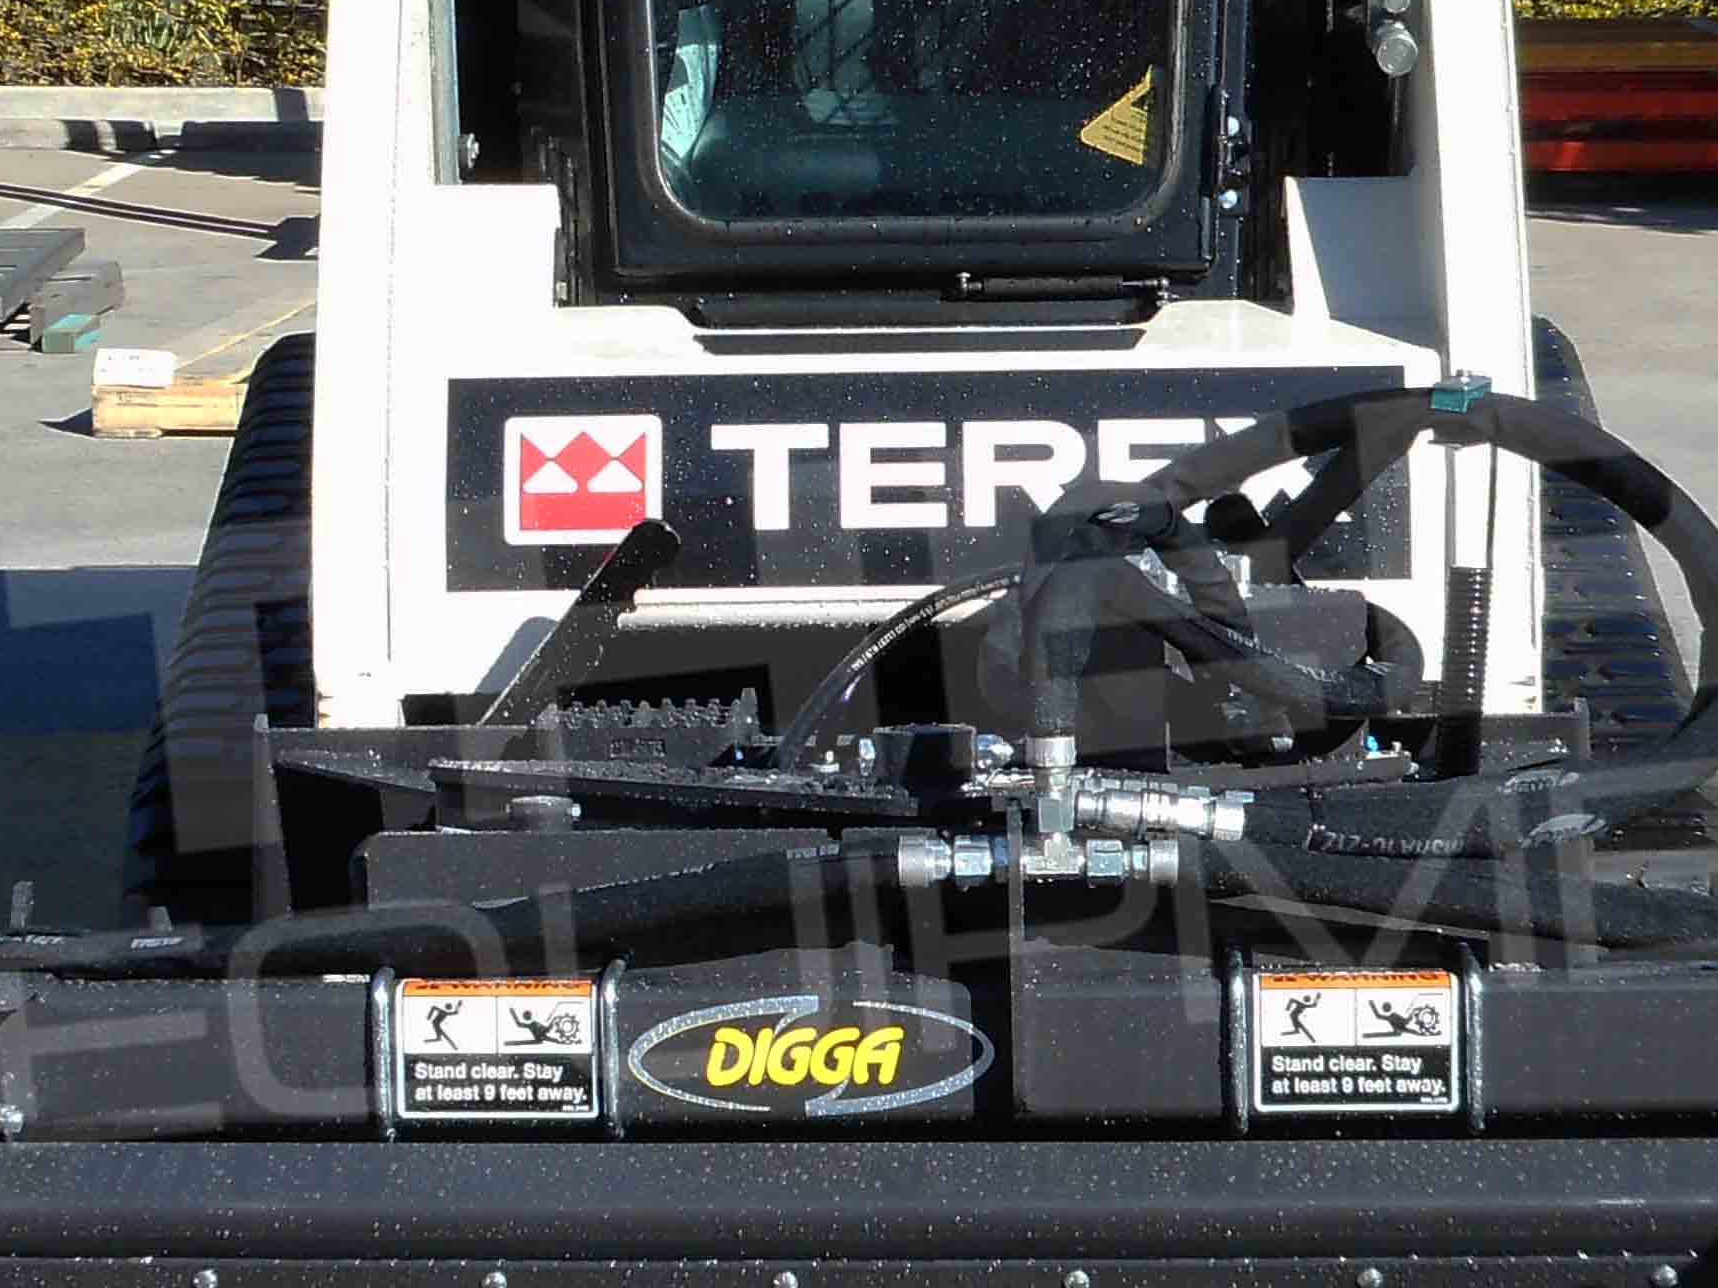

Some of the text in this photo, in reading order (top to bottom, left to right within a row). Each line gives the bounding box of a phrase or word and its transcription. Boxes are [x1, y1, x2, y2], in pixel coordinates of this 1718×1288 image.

[706, 1026, 905, 1087] DIGGA
[1271, 1054, 1423, 1075] Stand clear. Stay
[414, 1062, 563, 1083] Stand clear. Stay
[415, 1084, 587, 1104] at least 9 feet away.
[1271, 1077, 1447, 1096] at least 9 feet away.
